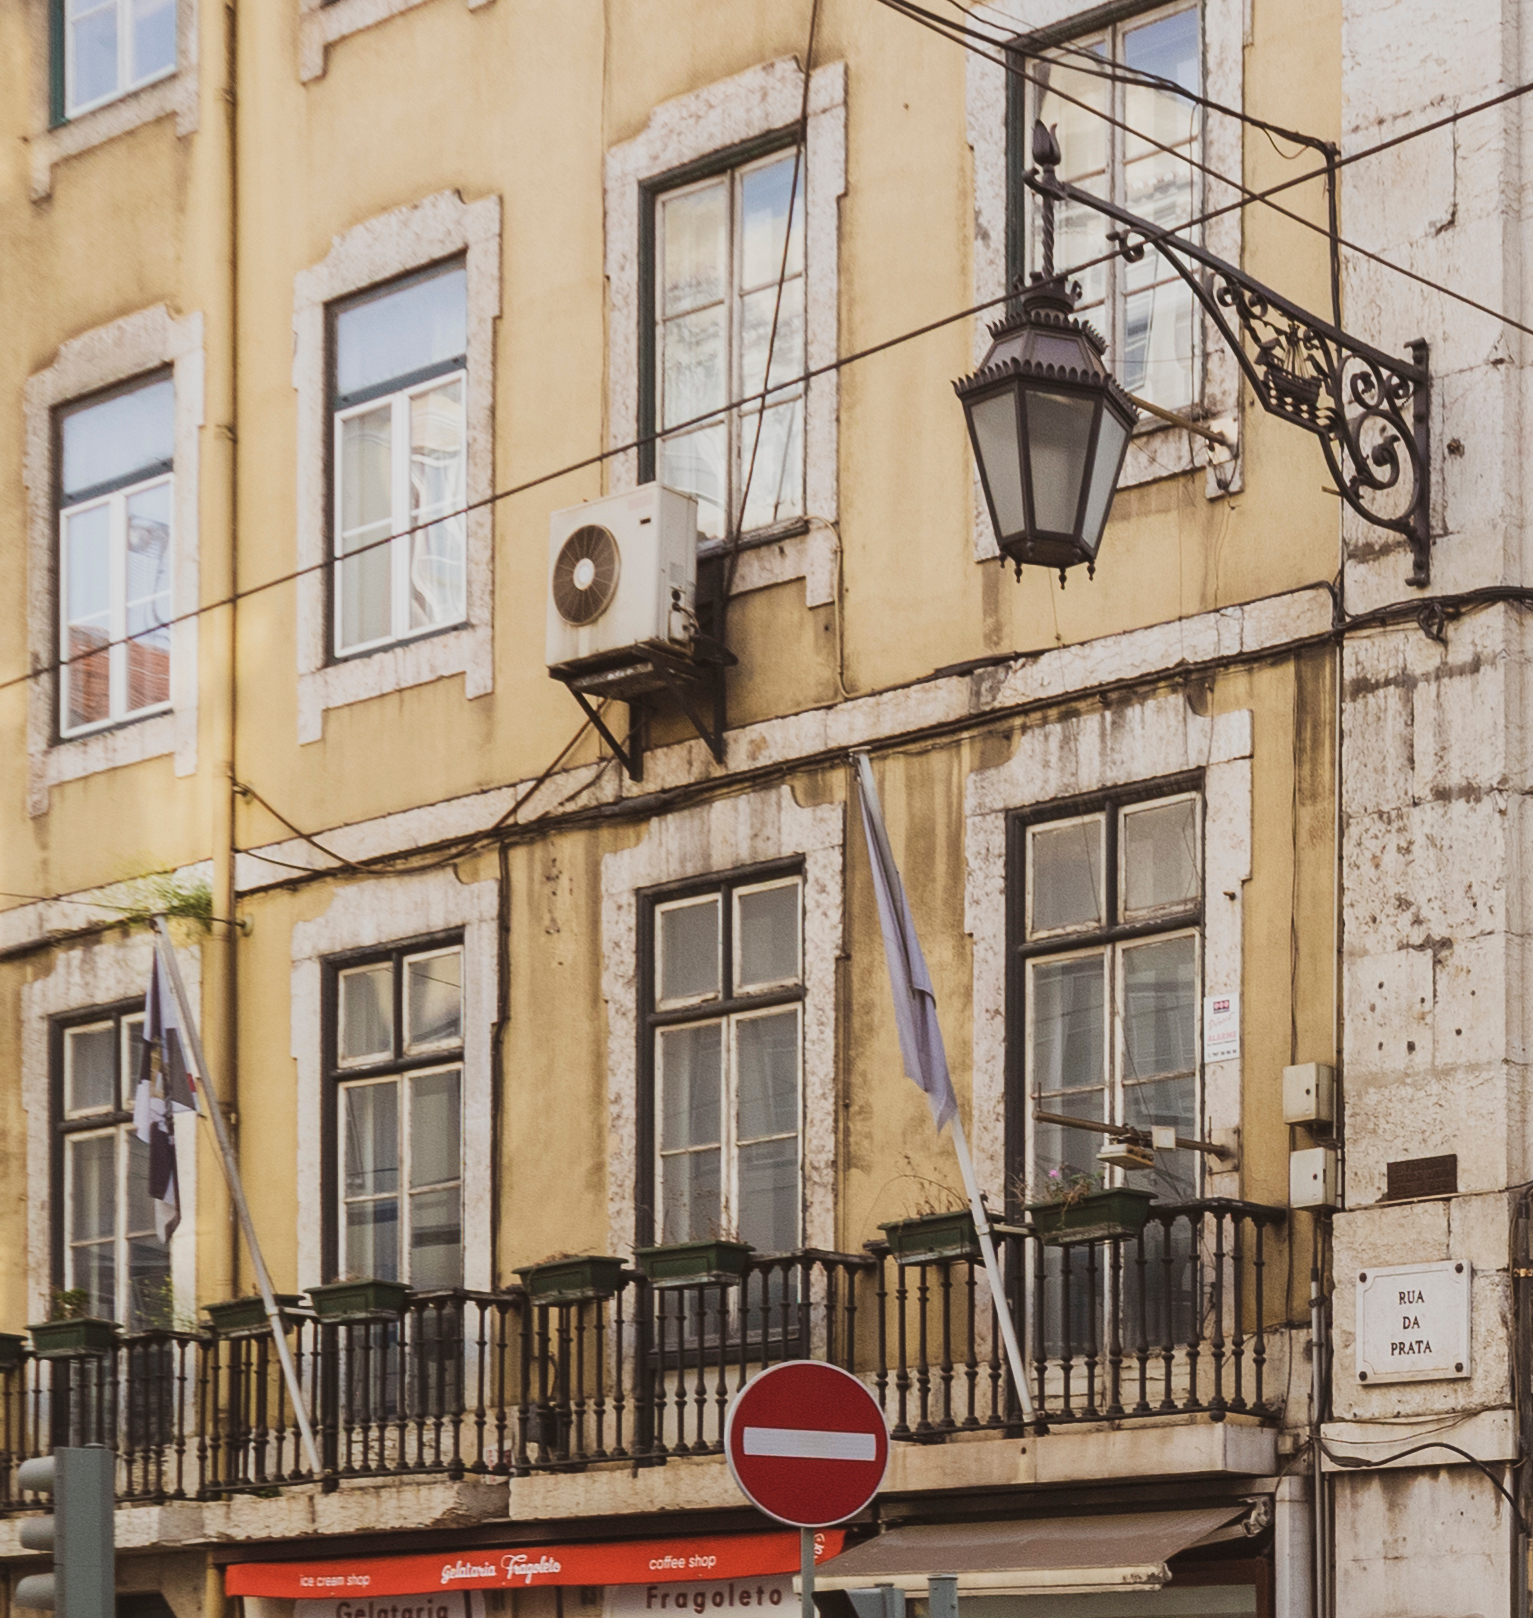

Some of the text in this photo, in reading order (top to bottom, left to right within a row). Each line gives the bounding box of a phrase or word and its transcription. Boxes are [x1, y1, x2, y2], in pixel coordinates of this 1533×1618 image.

[1398, 1290, 1425, 1305] RUA
[1402, 1316, 1420, 1329] DA
[1390, 1340, 1432, 1356] PRATA
[649, 1554, 716, 1570] coffee shop
[300, 1573, 370, 1588] ice cream shop
[646, 1582, 782, 1615] Fragoleto
